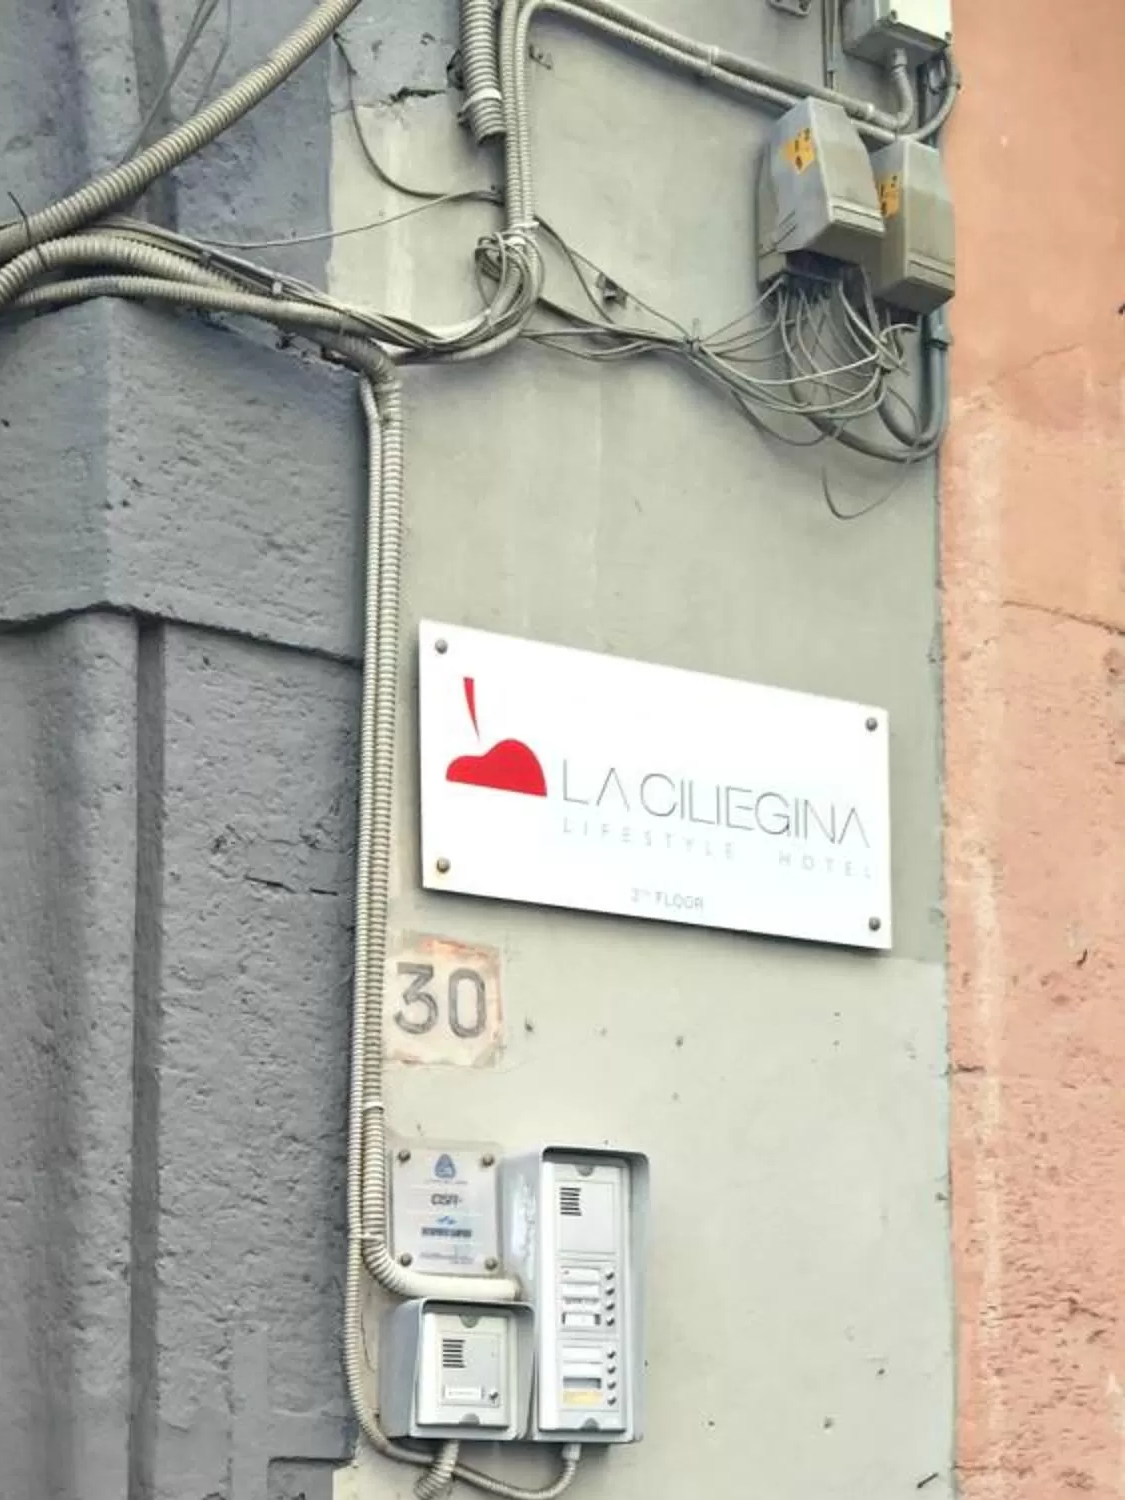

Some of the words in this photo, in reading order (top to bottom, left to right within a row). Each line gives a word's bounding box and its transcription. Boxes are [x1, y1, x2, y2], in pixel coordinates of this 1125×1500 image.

[562, 816, 735, 861] LIFESTYLE
[778, 850, 871, 880] HOTEL
[393, 961, 487, 1038] 30
